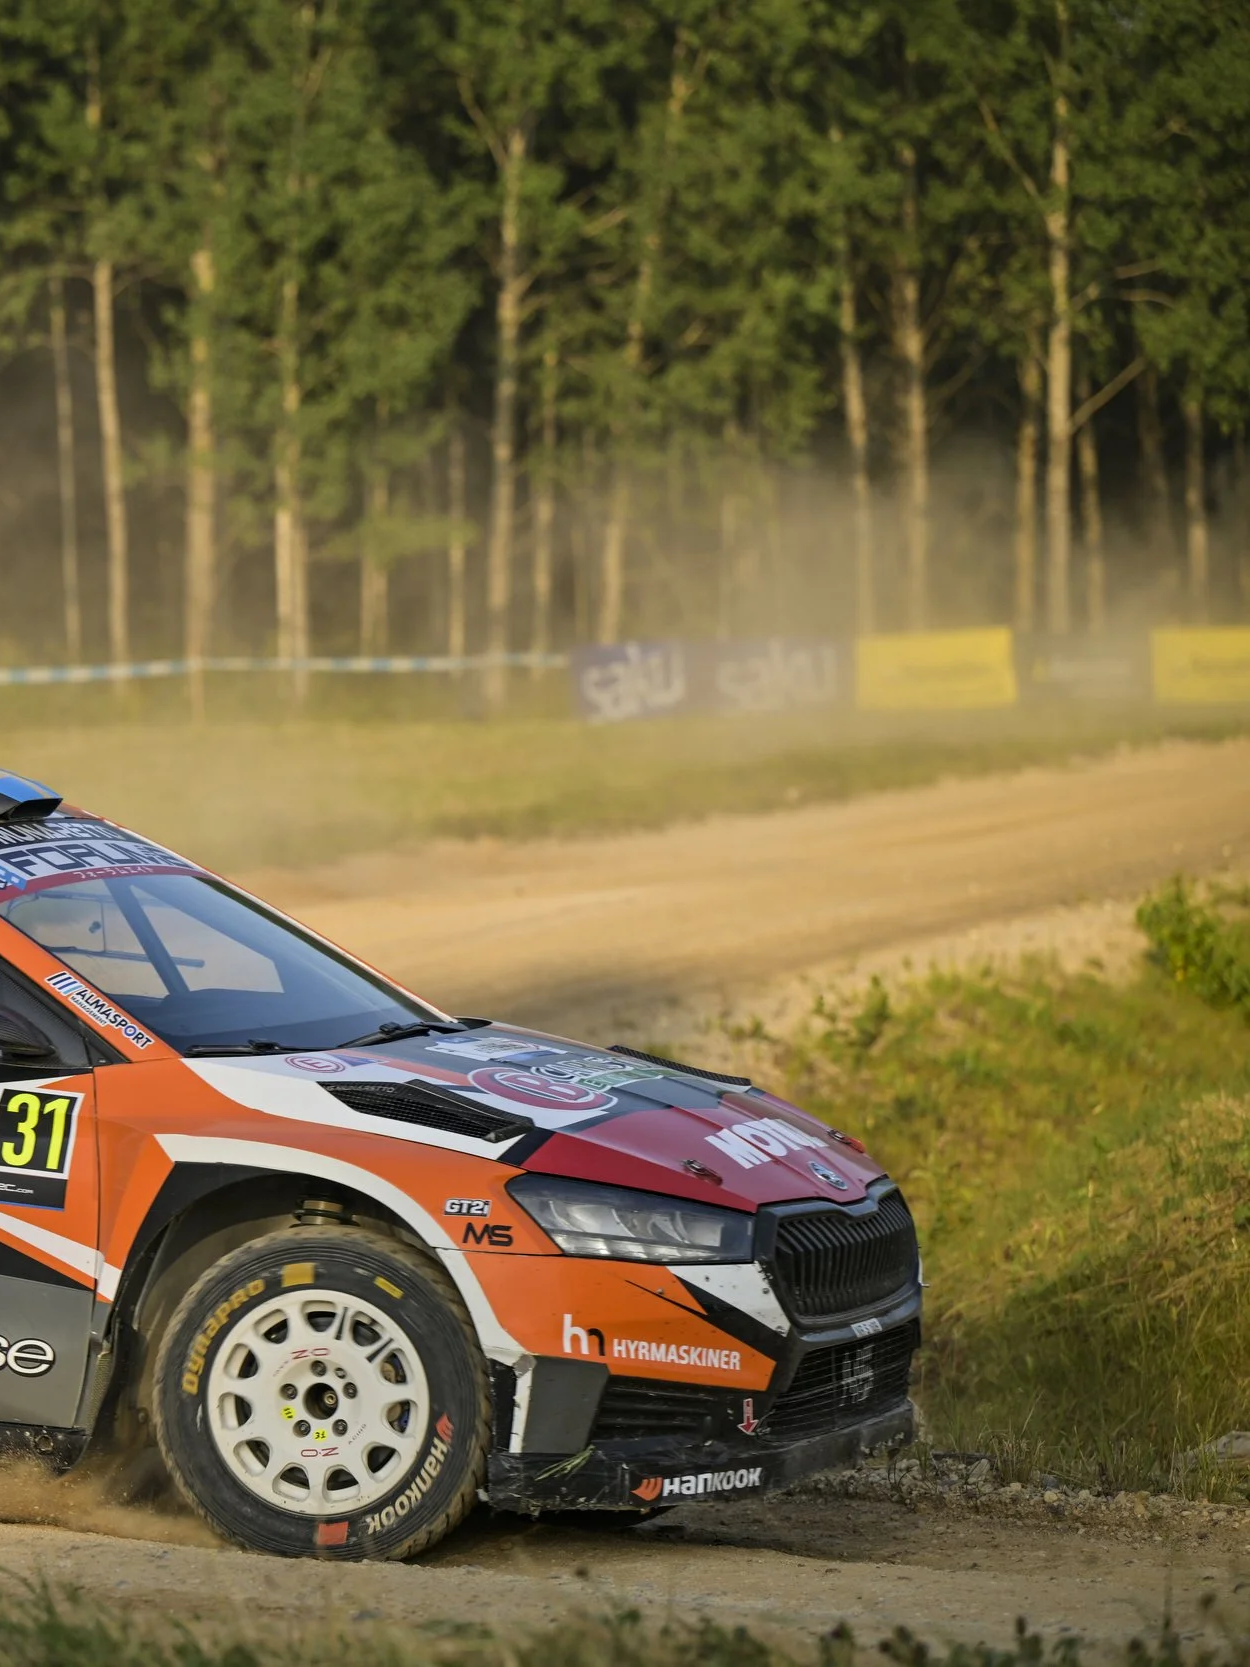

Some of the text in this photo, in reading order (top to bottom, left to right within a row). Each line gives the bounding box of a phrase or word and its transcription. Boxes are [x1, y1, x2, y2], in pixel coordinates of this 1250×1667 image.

[70, 995, 108, 1026] MANAGEMENT
[76, 989, 152, 1048] ALMASPORT
[1, 1092, 70, 1170] 31
[704, 1117, 830, 1169] MOTUL
[444, 1199, 490, 1217] GT2i
[462, 1222, 513, 1247] MS
[613, 1338, 741, 1371] HYRMASKINER
